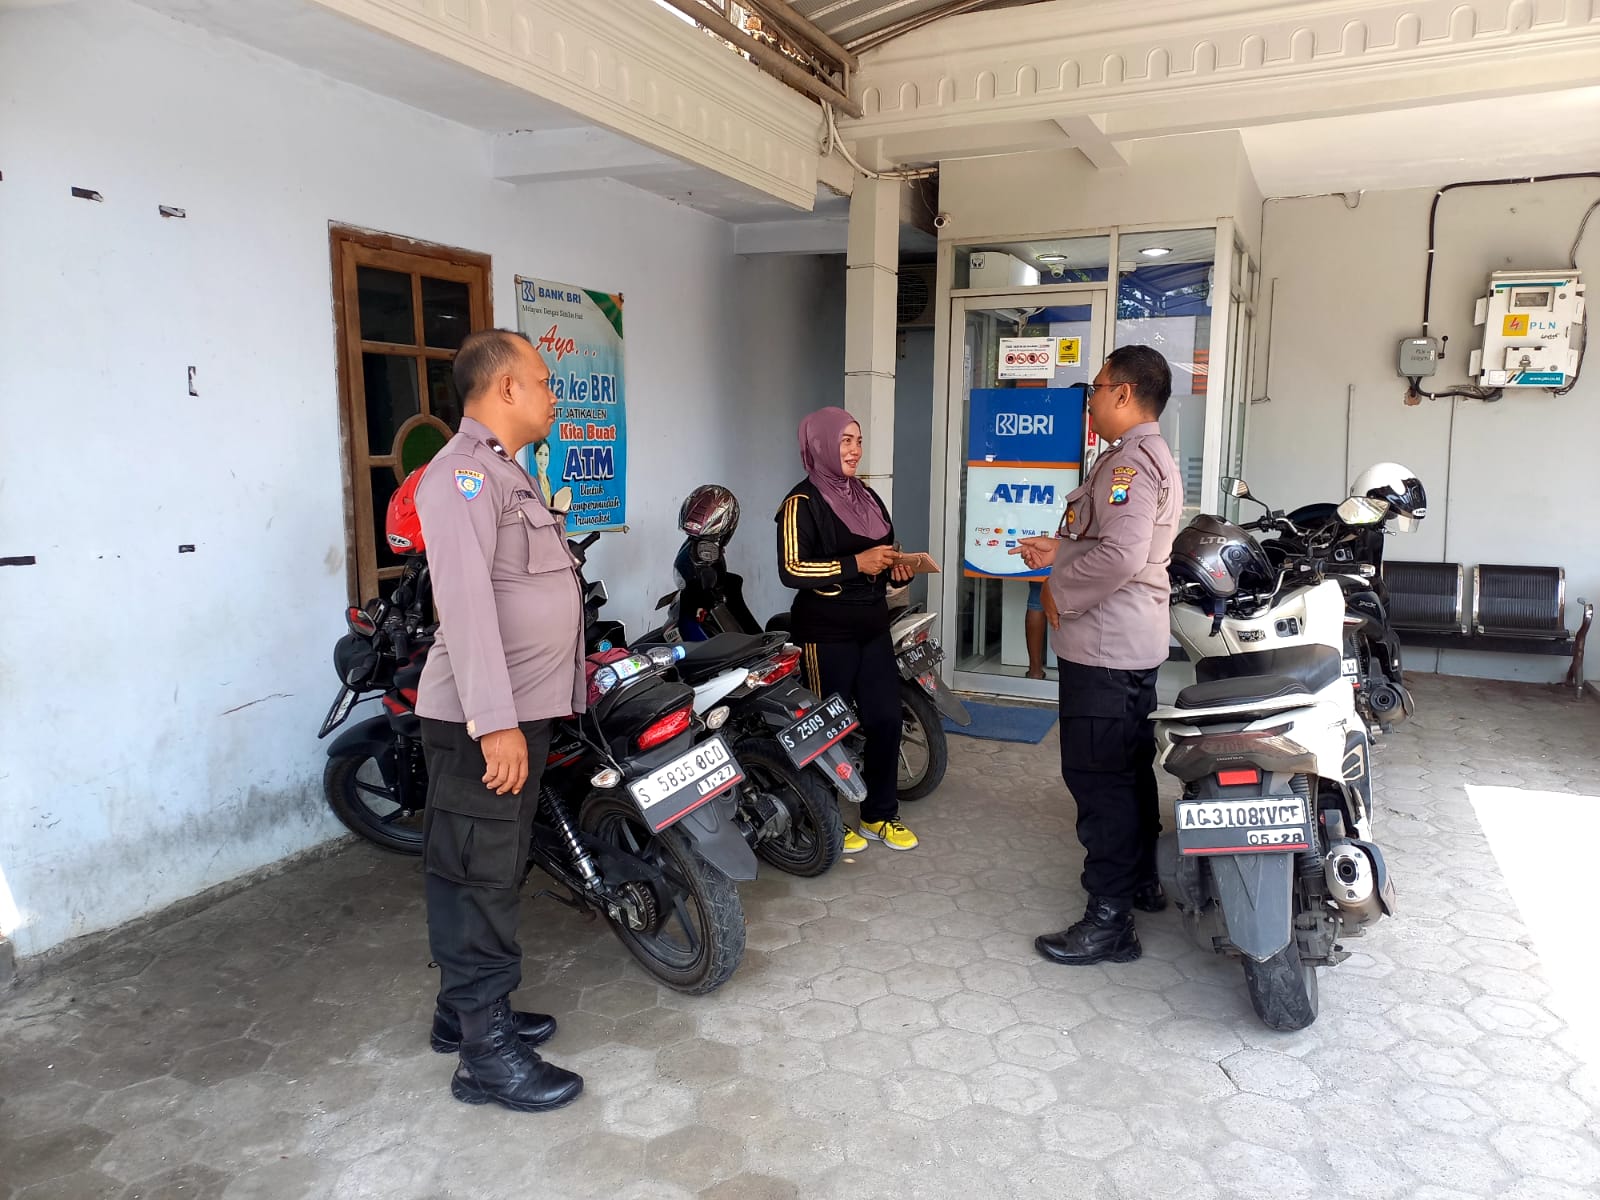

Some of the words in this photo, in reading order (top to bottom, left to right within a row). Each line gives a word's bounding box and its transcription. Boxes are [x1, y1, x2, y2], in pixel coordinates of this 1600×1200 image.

[538, 287, 564, 301] BANK
[566, 293, 582, 304] BRI
[1530, 321, 1556, 330] PLN
[568, 372, 588, 402] ke
[590, 373, 617, 403] BRI
[565, 408, 607, 419] JATIKALEN
[559, 422, 584, 441] Kita
[586, 423, 616, 441] Buat
[1018, 414, 1054, 435] BRI
[562, 446, 615, 481] ATM
[989, 483, 1054, 504] ATM
[1199, 536, 1227, 545] LTD
[783, 735, 796, 748] S
[796, 714, 825, 740] 2509
[825, 699, 845, 719] MK
[637, 786, 651, 804] S
[657, 760, 696, 793] 5835
